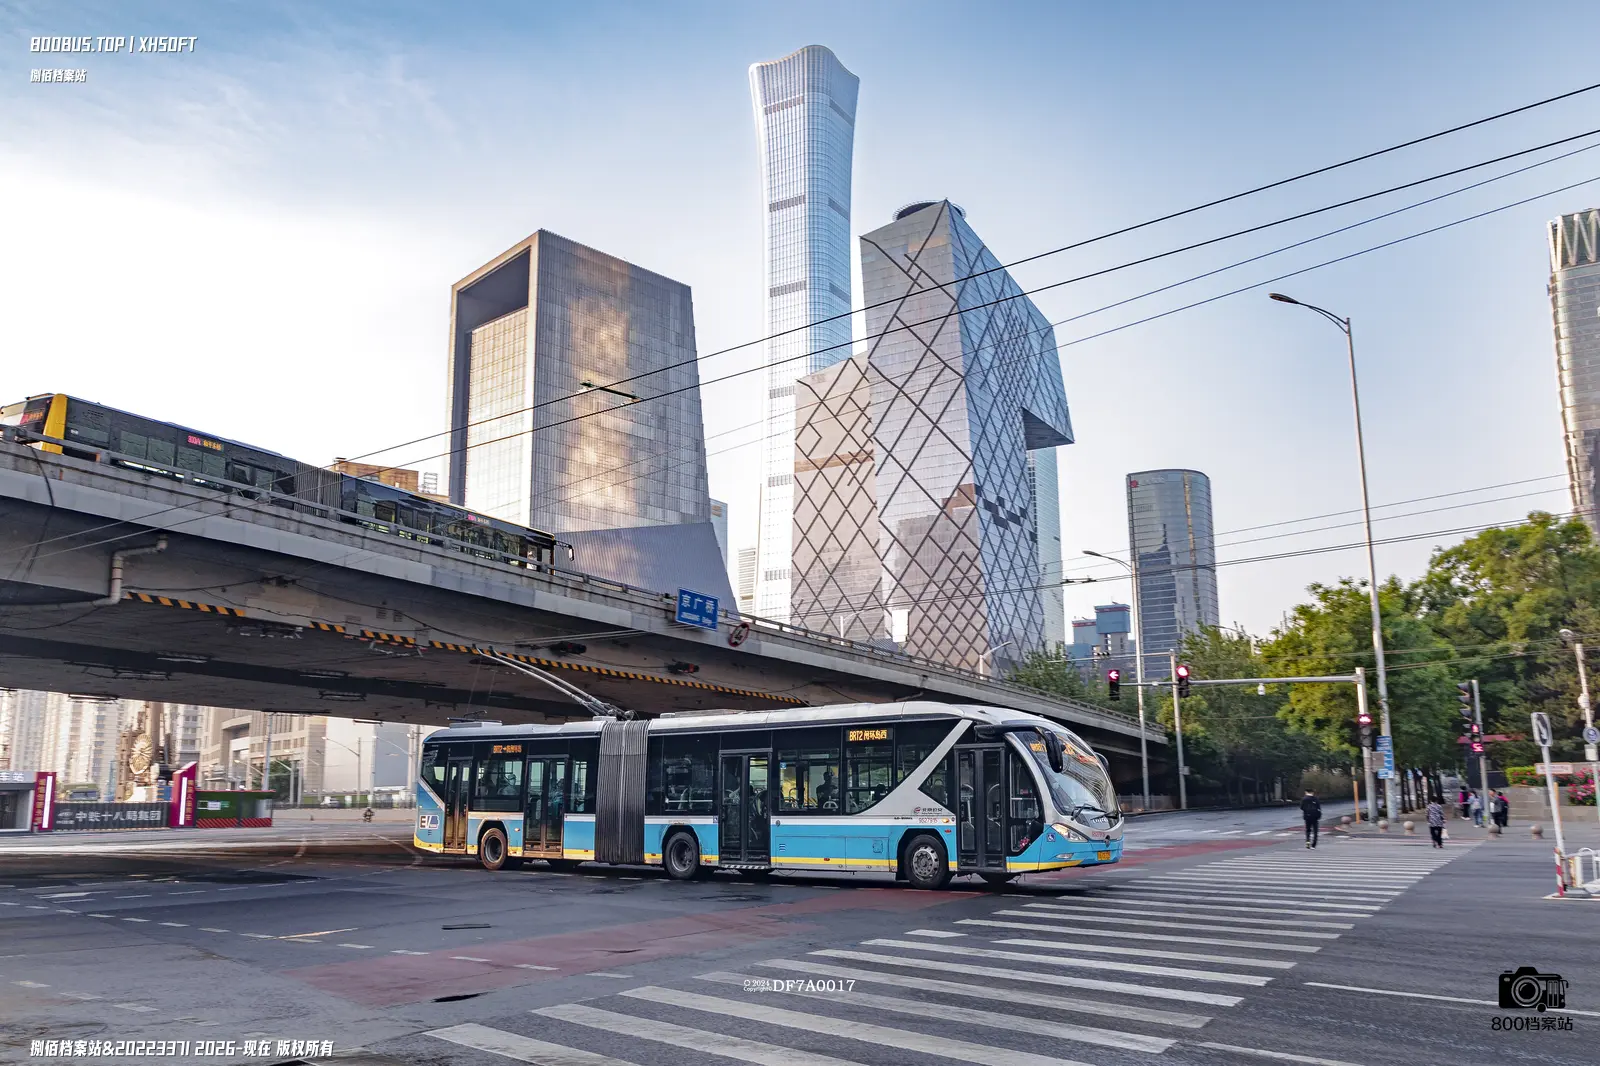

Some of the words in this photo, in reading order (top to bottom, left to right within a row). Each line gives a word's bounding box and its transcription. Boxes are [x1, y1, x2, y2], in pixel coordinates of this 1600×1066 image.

[849, 730, 864, 741] BRT2
[75, 810, 162, 823] 中铁十八局集团
